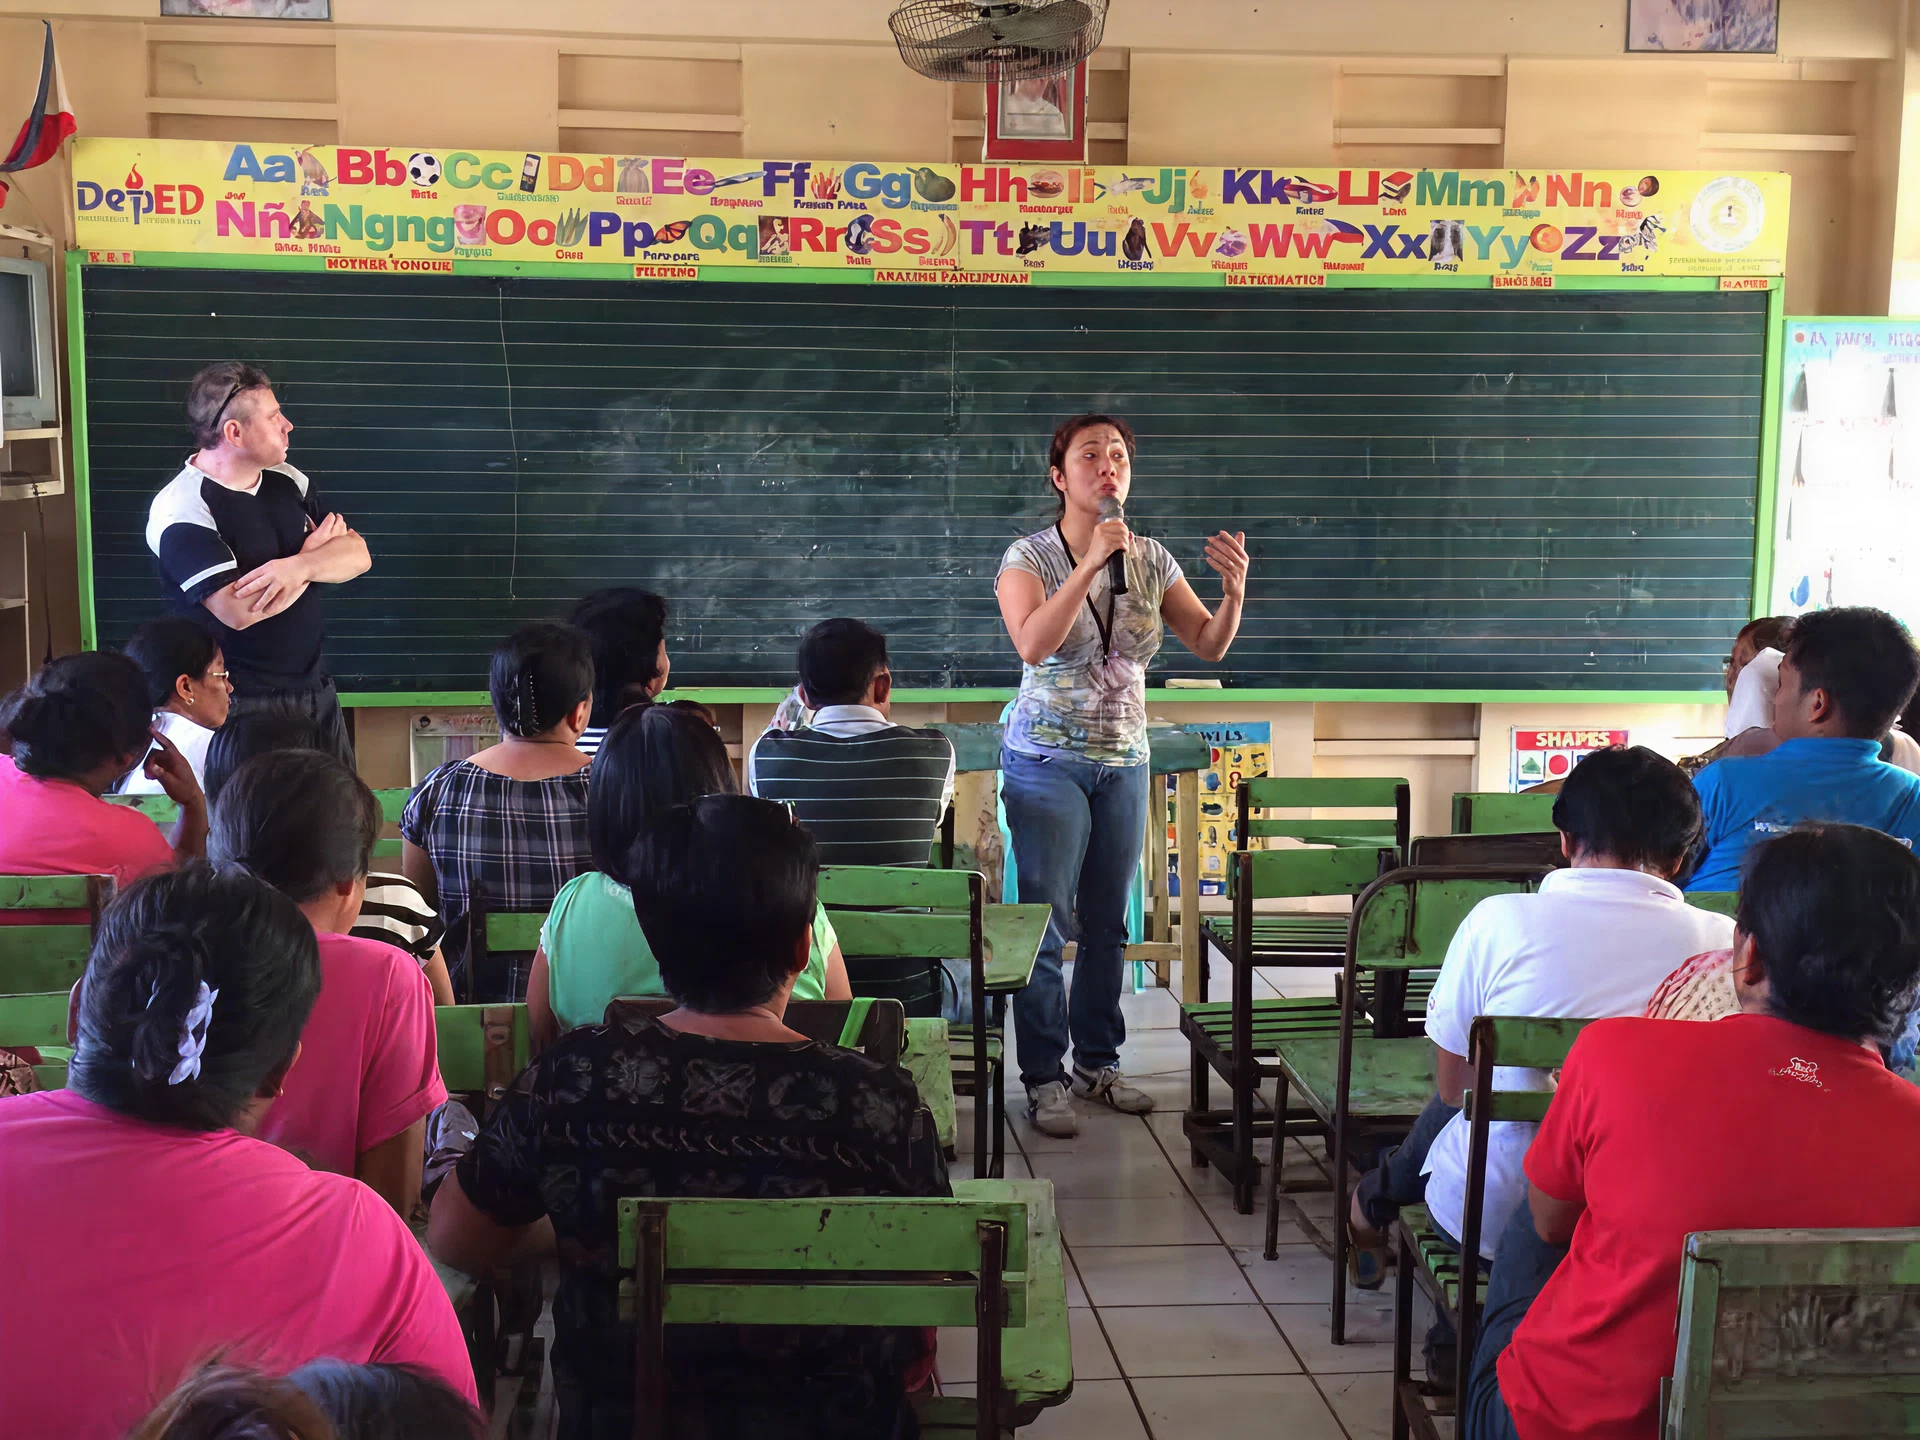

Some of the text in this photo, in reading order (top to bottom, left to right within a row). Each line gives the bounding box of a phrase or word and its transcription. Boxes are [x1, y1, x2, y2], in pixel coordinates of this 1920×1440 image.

[223, 144, 296, 183] Aa
[337, 148, 407, 187] Bb
[444, 152, 513, 190] Cc
[548, 155, 614, 193] Dd
[652, 158, 716, 196] Ee
[762, 161, 811, 197] Ff
[844, 163, 911, 209] Gg
[960, 167, 1028, 202] Hh
[1142, 168, 1186, 214] Jj
[1223, 169, 1291, 204] Kk
[1416, 171, 1505, 207] Mm
[1545, 173, 1612, 208] Nn
[215, 200, 1620, 269] Nñ Ngng Oo Pp Qq Rr Ss Tt Uu Vv Ww Xx Yy Zz
